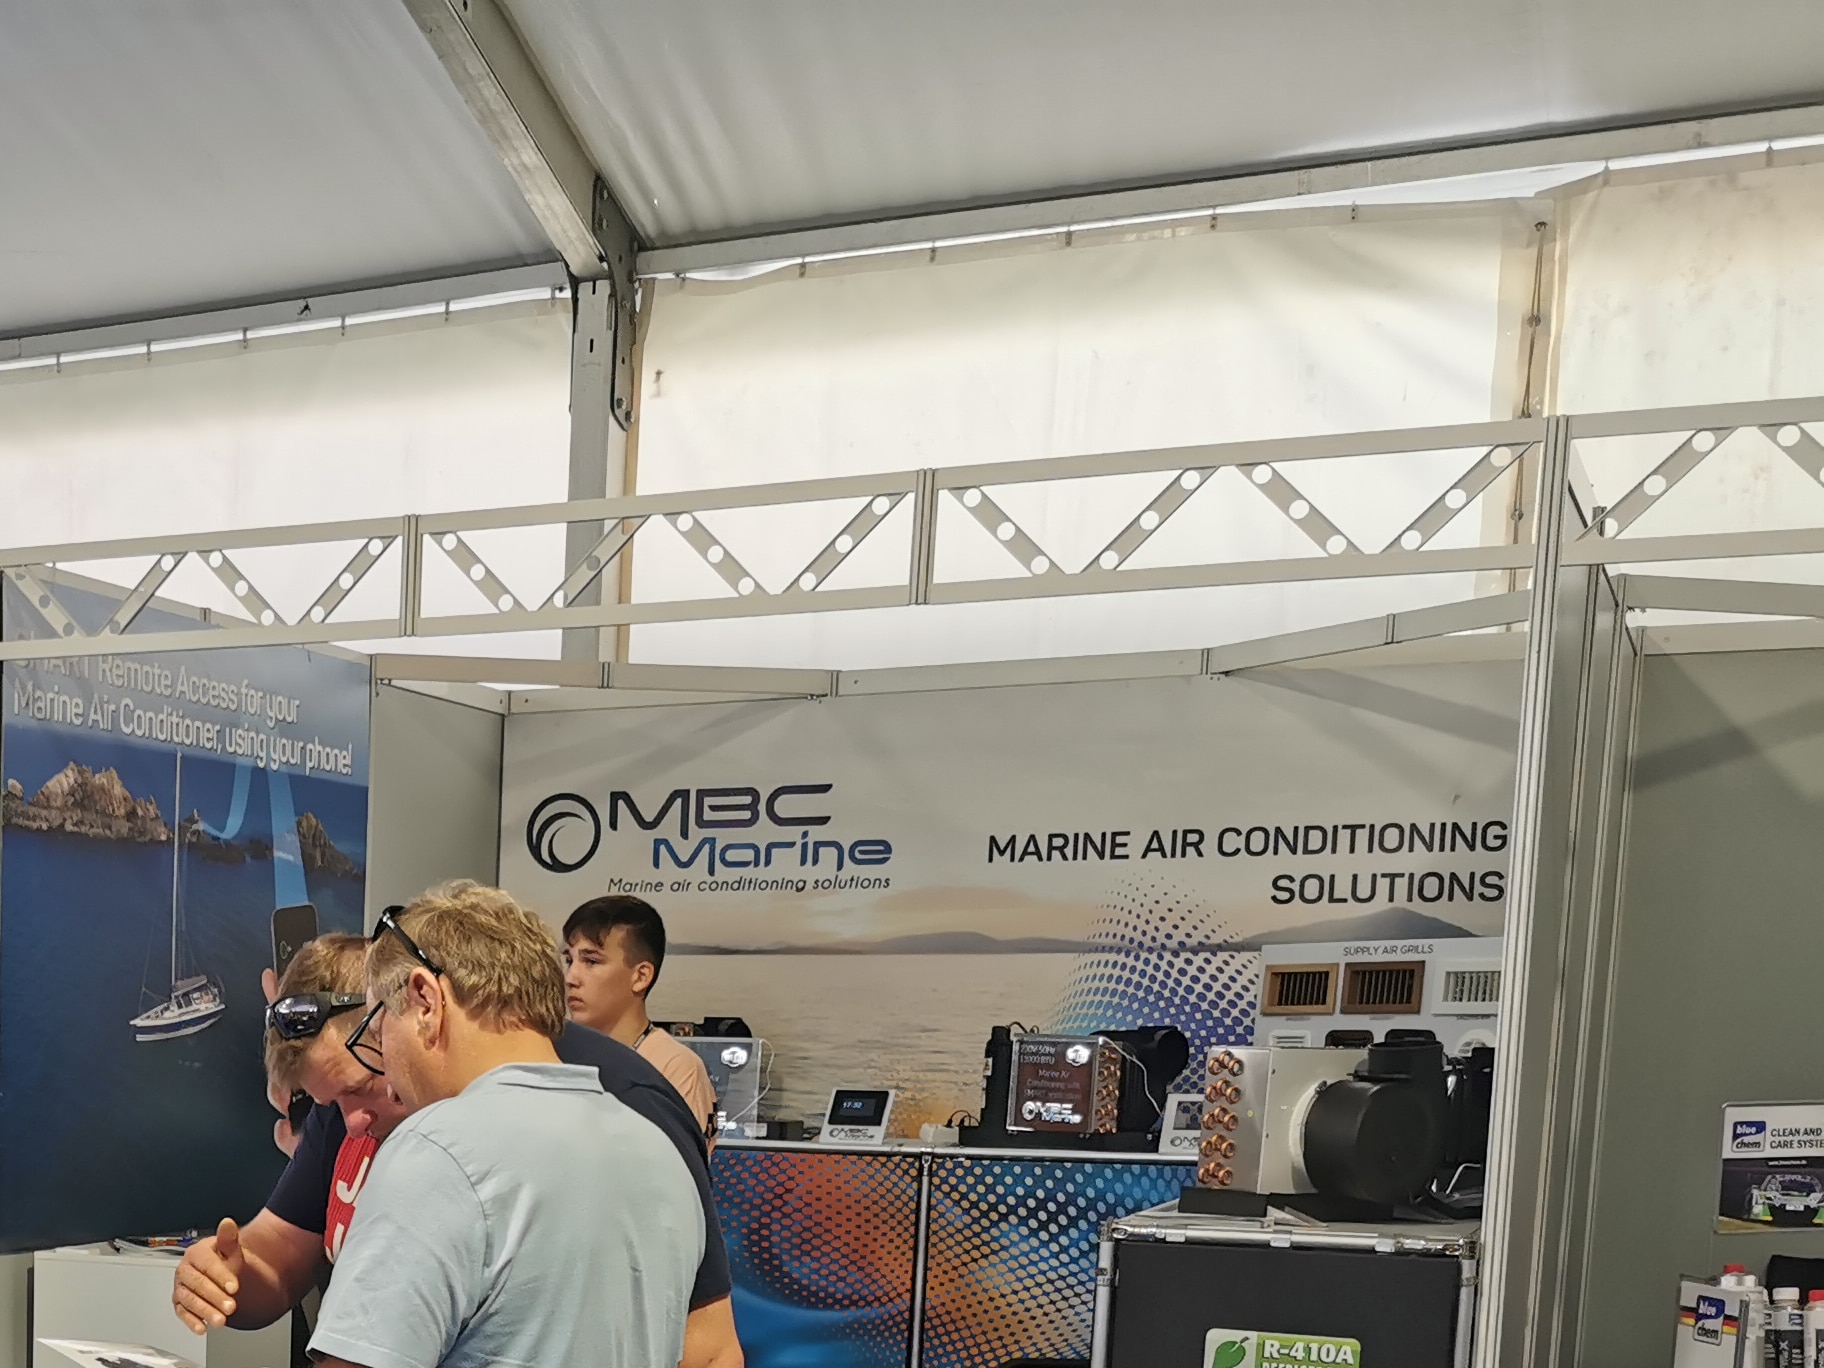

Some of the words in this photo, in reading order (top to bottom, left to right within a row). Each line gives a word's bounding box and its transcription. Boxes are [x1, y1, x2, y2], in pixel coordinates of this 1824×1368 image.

[98, 655, 172, 697] Remote
[176, 665, 238, 711] Access
[241, 679, 264, 716] for
[266, 693, 301, 728] your
[14, 677, 84, 726] Marine
[88, 693, 116, 731] Air
[120, 697, 222, 755] Conditioner,
[226, 722, 267, 769] using
[269, 734, 304, 771] your
[305, 735, 353, 776] phone!
[608, 783, 834, 841] MBC
[987, 830, 1131, 864] MARINE
[1141, 828, 1205, 861] AIR
[1216, 820, 1509, 858] CONDITIONING
[651, 830, 893, 877] Marine
[607, 877, 664, 893] Marine
[669, 878, 693, 893] air
[697, 876, 807, 893] conditioning
[811, 874, 891, 891] solutions
[1269, 870, 1506, 905] SOLUTIONS
[1342, 946, 1381, 957] SUPPLY
[1381, 945, 1399, 955] AIR
[1400, 943, 1434, 955] GRILLS
[1736, 1123, 1757, 1134] blue
[1770, 1127, 1801, 1138] CLEAN
[1802, 1127, 1823, 1137] AND
[1735, 1138, 1762, 1150] chem
[1769, 1140, 1795, 1149] CARE
[1698, 1299, 1717, 1317] blue
[1696, 1321, 1720, 1341] chem
[1262, 1338, 1355, 1366] R-410A
